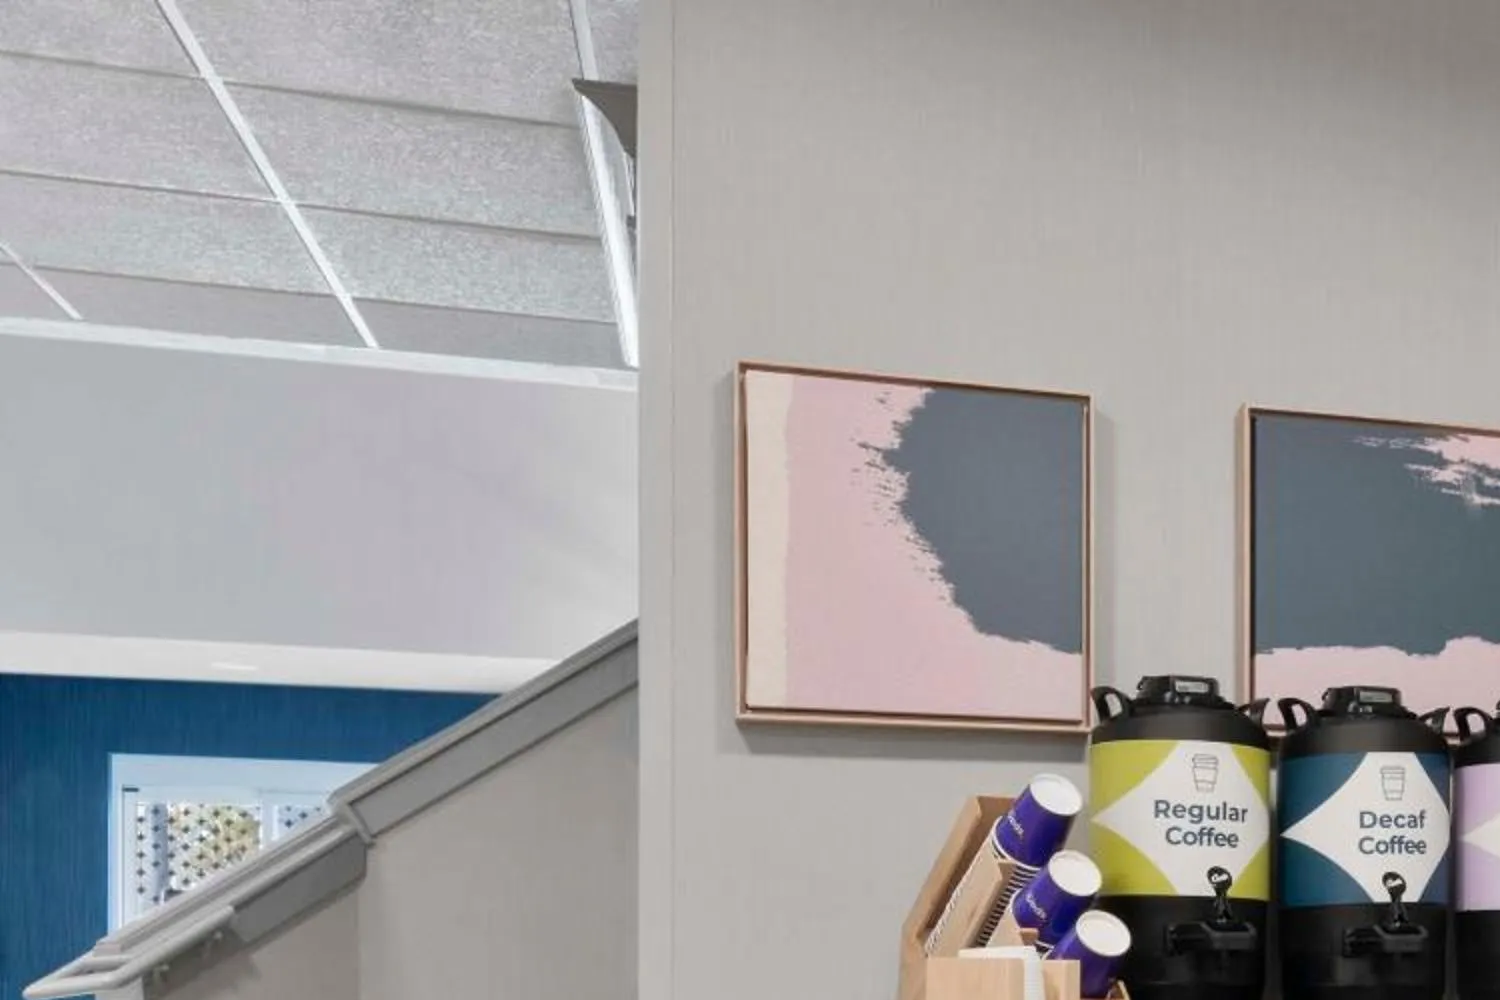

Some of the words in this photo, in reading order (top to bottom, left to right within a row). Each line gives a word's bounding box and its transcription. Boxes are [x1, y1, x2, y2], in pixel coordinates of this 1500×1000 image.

[1153, 799, 1249, 825] Regular
[1359, 809, 1427, 829] Decaf
[1165, 826, 1240, 849] Coffee
[1358, 835, 1427, 855] Coffee
